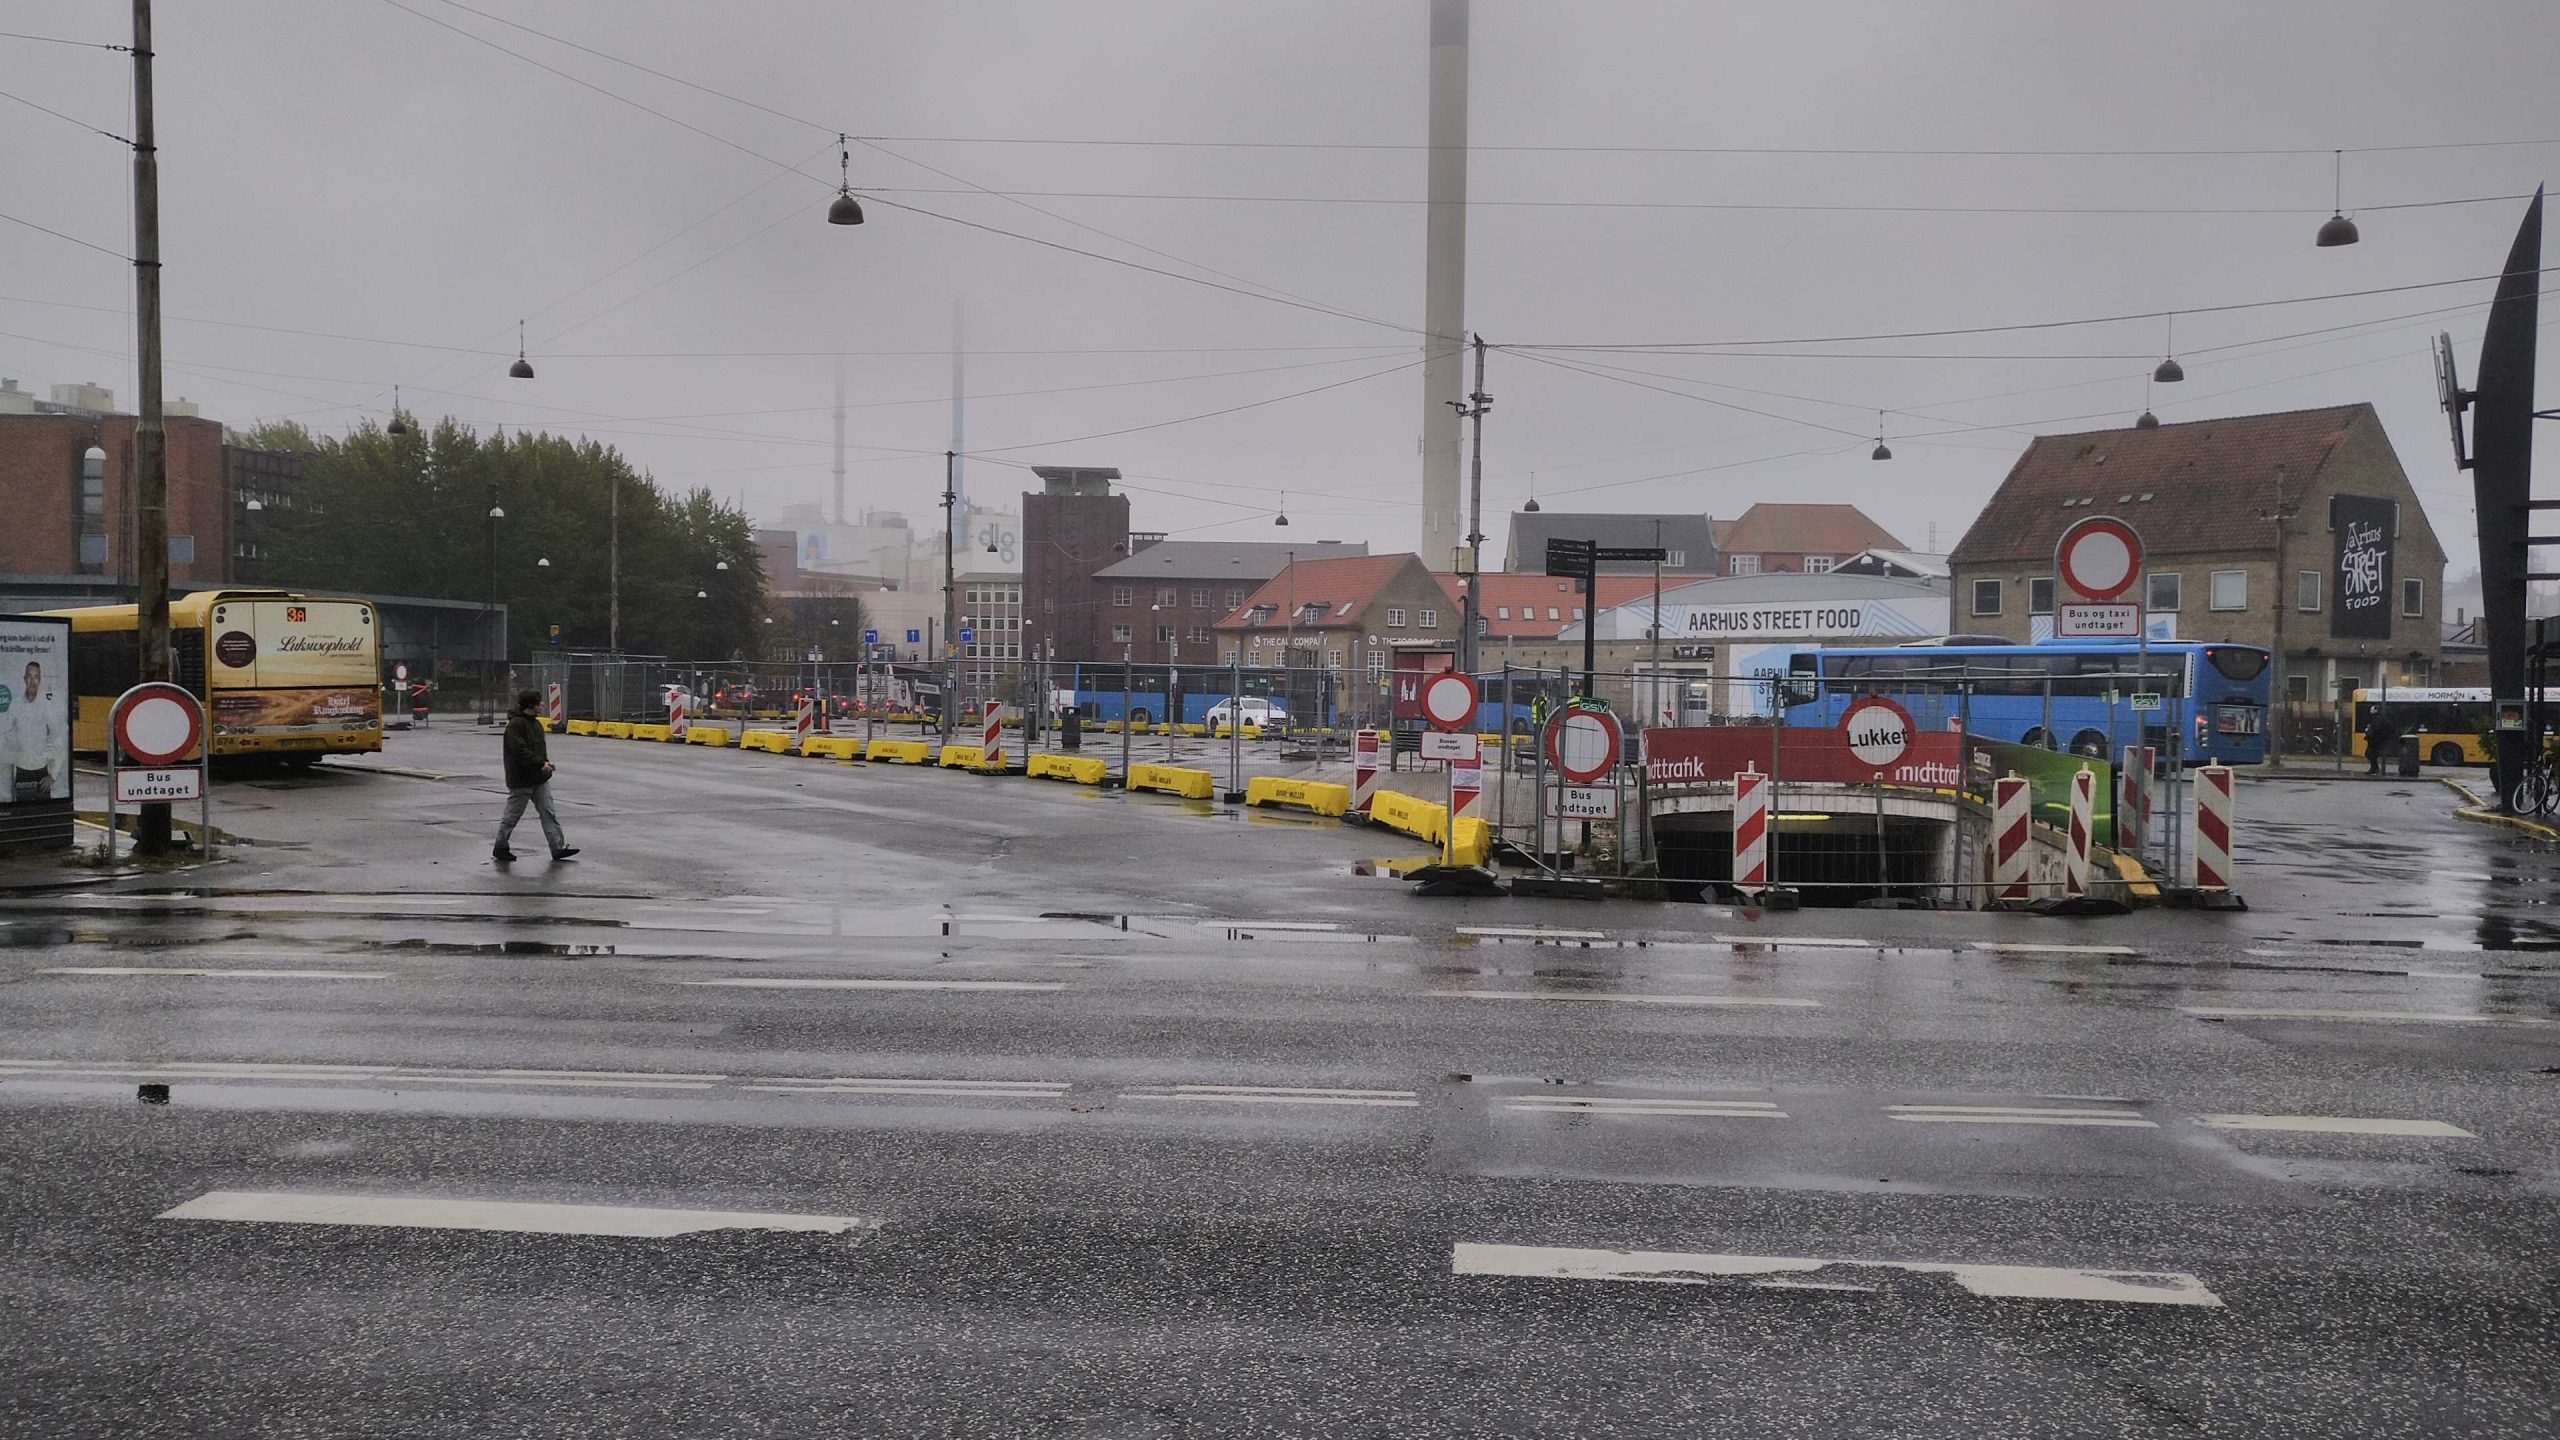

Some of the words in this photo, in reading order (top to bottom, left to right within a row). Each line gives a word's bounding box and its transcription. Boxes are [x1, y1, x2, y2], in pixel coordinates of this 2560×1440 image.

[978, 523, 1015, 564] dlg
[2345, 595, 2380, 610] FOOD
[288, 607, 305, 621] 3A
[2069, 609, 2089, 618] Bus
[2092, 611, 2105, 619] og
[2109, 609, 2130, 618] taxi
[1689, 611, 1749, 631] AARHUS
[1753, 610, 1812, 630] STREET
[1817, 609, 1861, 628] FOOD
[2075, 621, 2124, 630] undtaget
[277, 635, 364, 657] Luksusophold
[1263, 637, 1276, 647] THE
[1276, 637, 1293, 646] CAL
[1754, 667, 1788, 679] AARHU
[2428, 690, 2465, 699] MORMON
[1848, 727, 1909, 747] Lukket
[147, 773, 171, 782] Bus
[128, 785, 189, 796] undtaget
[1571, 790, 1592, 800] Bus
